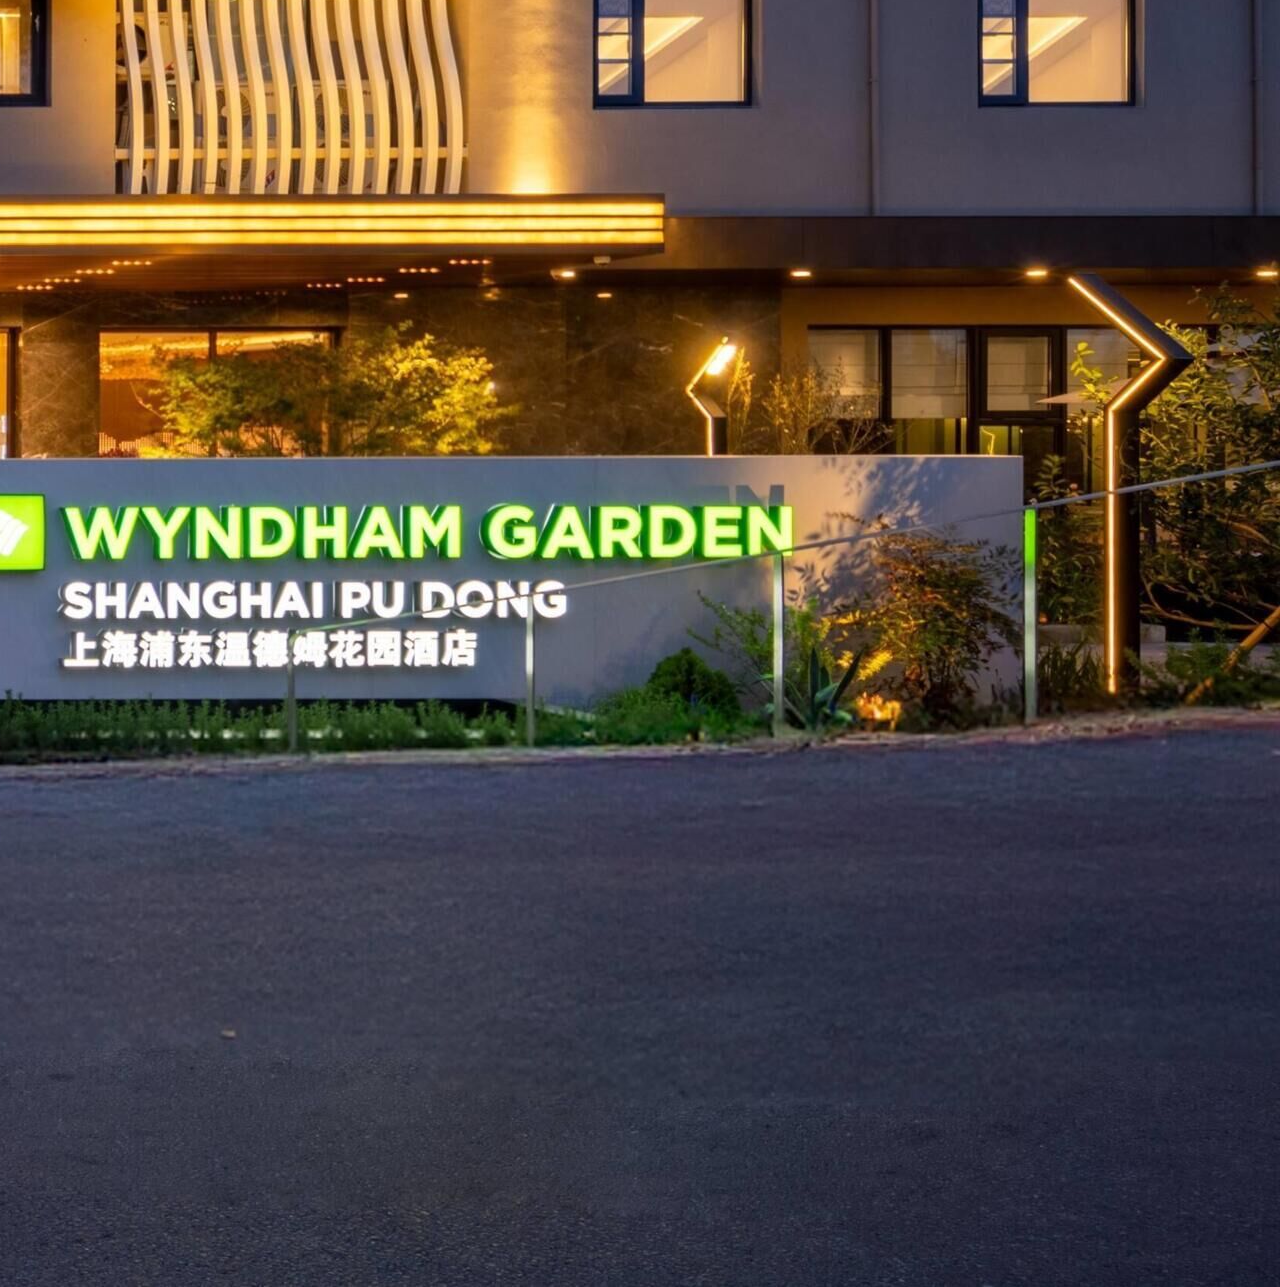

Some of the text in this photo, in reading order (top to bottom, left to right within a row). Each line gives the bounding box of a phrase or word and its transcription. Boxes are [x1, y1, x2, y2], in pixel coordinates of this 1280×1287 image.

[62, 504, 793, 560] WYNDHAM GARDEN
[62, 580, 568, 620] SHANGHAI PU DONG
[62, 630, 478, 669] 上海浦东温德姆花园酒店
